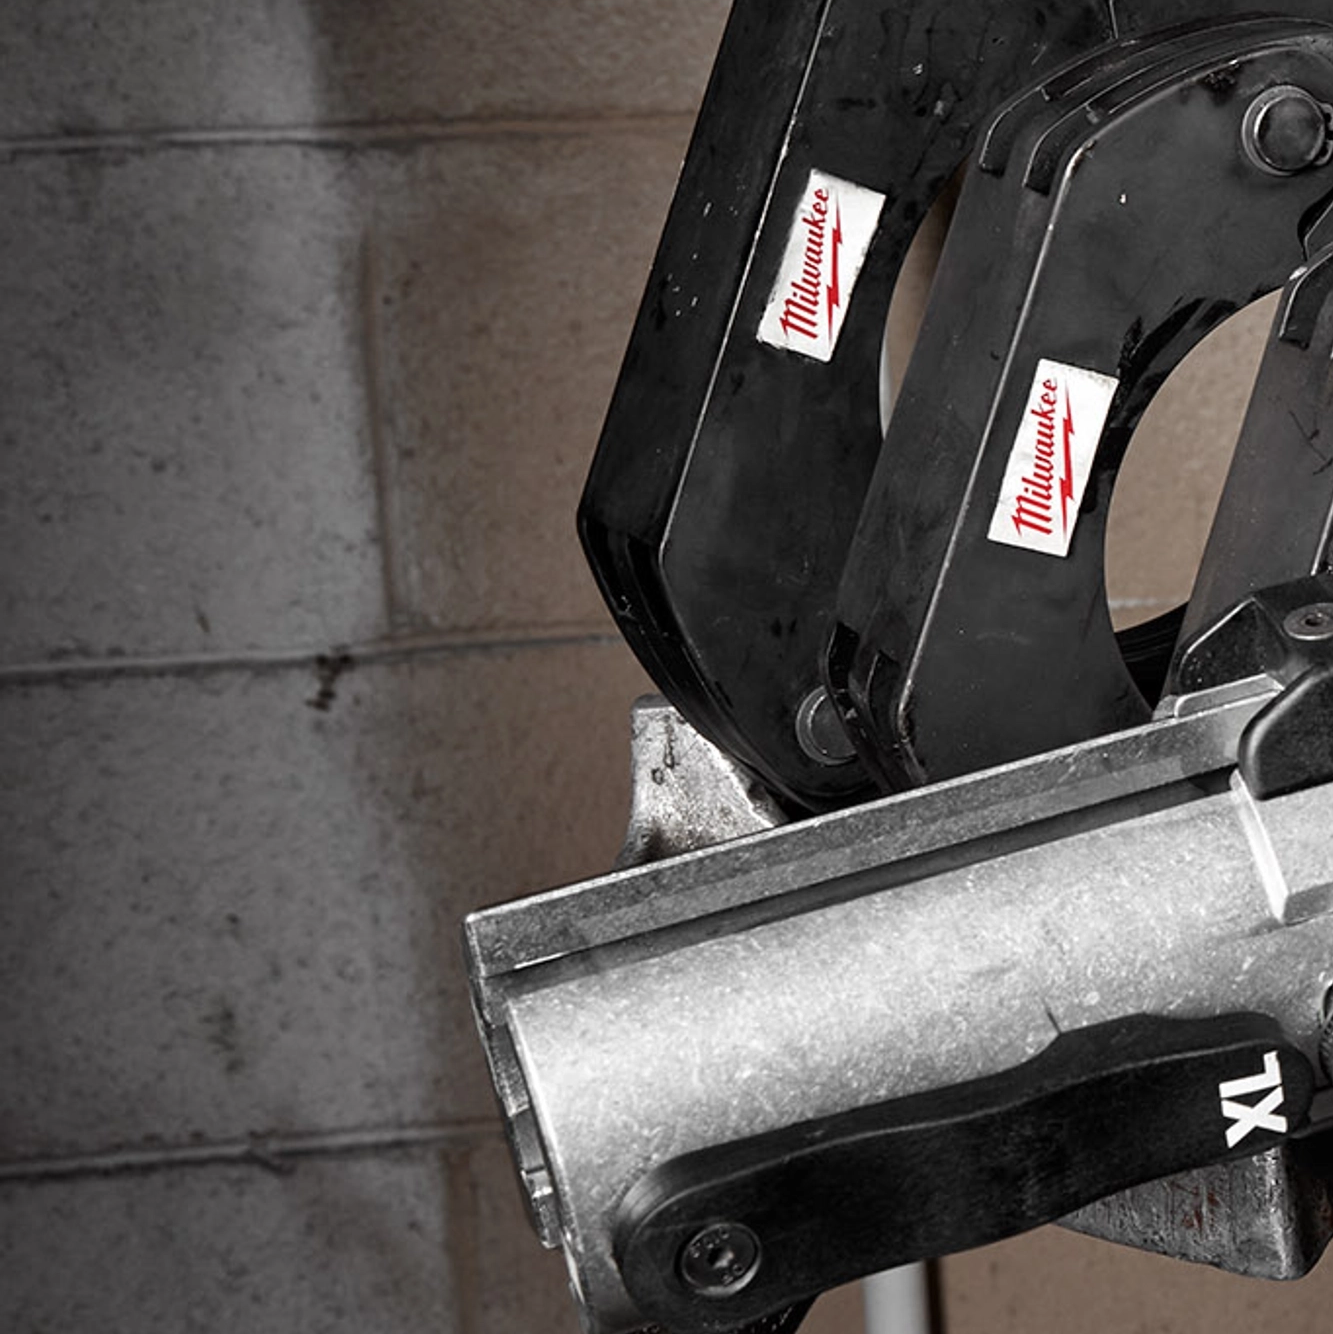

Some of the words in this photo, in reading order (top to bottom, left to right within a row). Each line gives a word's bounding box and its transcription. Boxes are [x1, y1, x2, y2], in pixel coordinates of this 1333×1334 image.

[780, 186, 829, 339] Milwaukee
[1011, 378, 1058, 535] Milwaukee
[1219, 1051, 1288, 1148] XL
